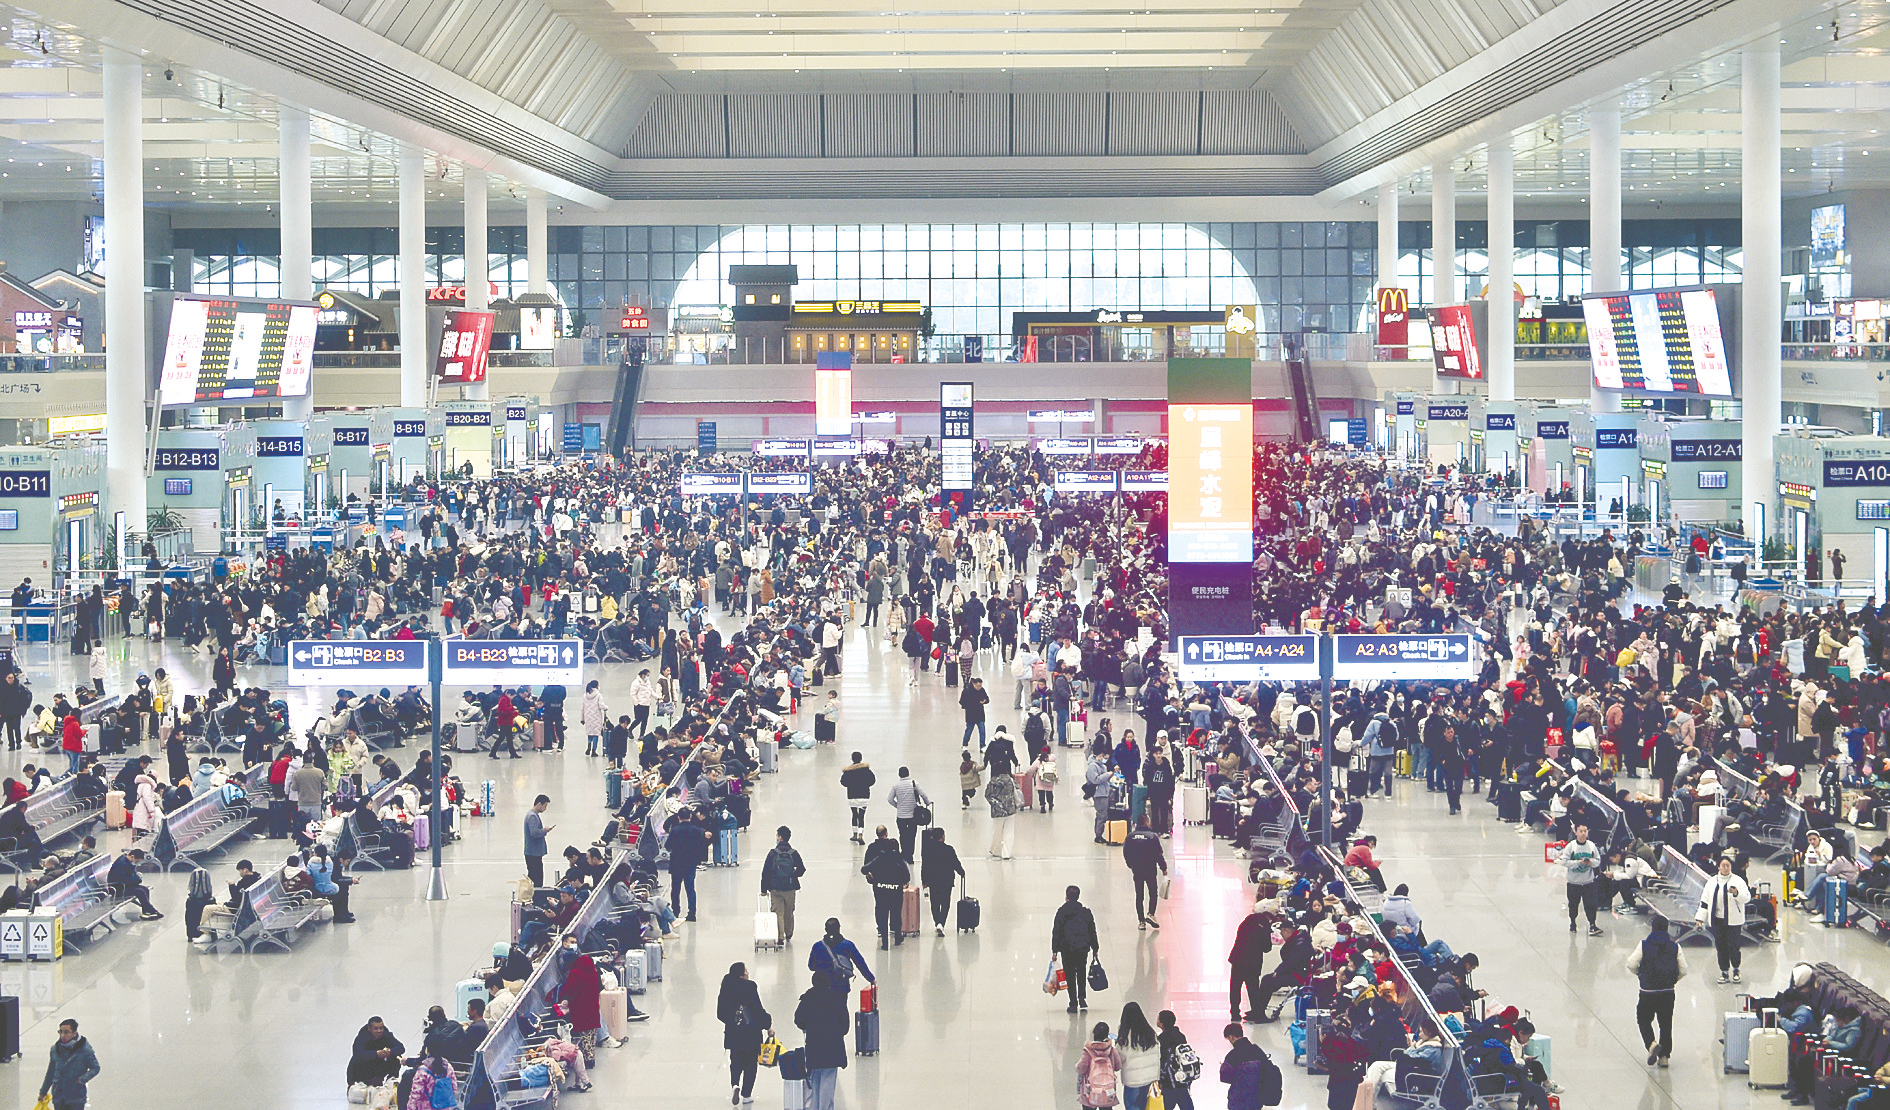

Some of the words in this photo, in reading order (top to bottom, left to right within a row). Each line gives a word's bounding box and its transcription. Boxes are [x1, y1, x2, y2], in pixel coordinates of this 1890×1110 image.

[428, 286, 466, 300] KFC
[966, 342, 980, 358] 北
[1, 384, 29, 393] 北广场
[454, 415, 490, 423] B20-B21
[1696, 444, 1742, 456] A12-A1
[162, 454, 216, 466] B12-B13
[1830, 467, 1852, 475] 检票口
[1192, 586, 1230, 594] 便民充电桩
[334, 646, 363, 657] 检票口
[1224, 642, 1254, 652] 检票口
[1254, 644, 1304, 657] A4-A24
[1398, 641, 1428, 652] 检票口
[457, 648, 508, 662] B4-B23
[508, 646, 537, 657] 检票口
